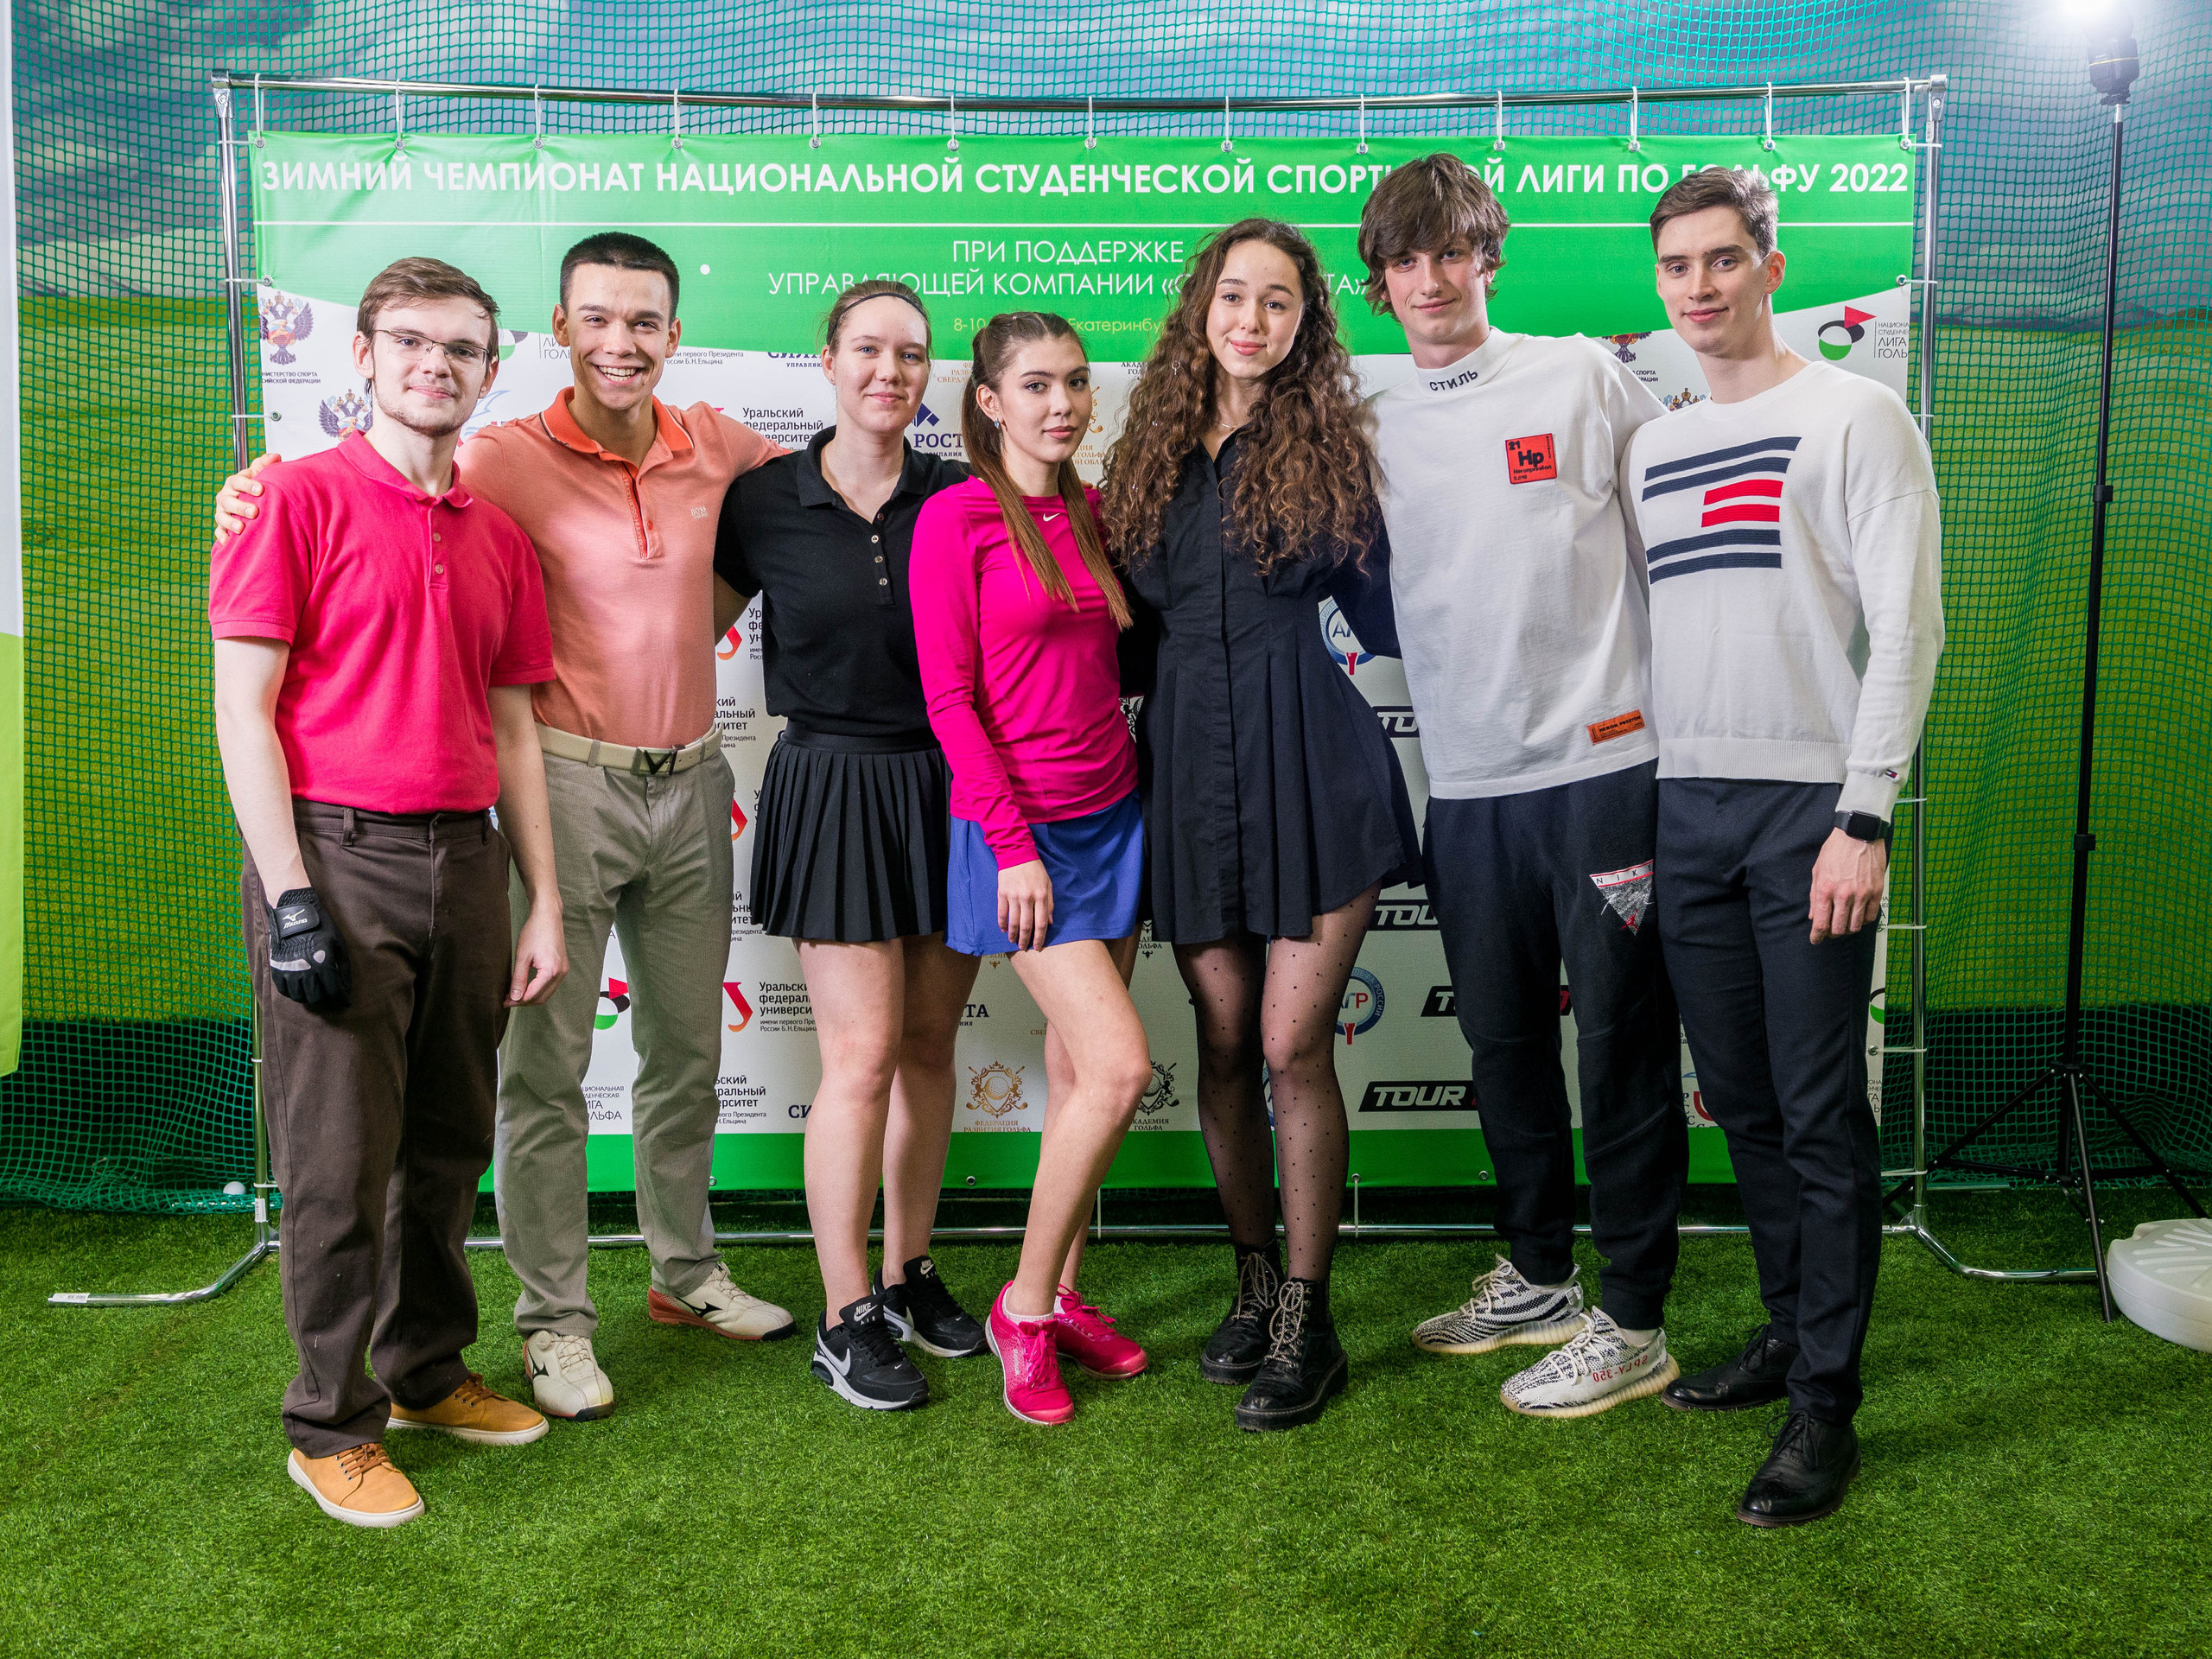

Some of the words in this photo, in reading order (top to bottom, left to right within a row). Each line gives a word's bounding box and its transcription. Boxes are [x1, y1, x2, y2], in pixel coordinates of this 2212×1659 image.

[262, 155, 412, 191] ЗИМНИЙ
[424, 162, 645, 192] ЧЕМПИОНАТ
[656, 156, 963, 195] НАЦИОНАЛЬНОЙ
[975, 157, 1254, 196] СТУДЕНЧЕСКОЙ
[1515, 164, 1604, 193] ЛИГИ
[1618, 163, 1669, 193] ПО
[1828, 162, 1908, 193] 2022
[953, 240, 1005, 263] ПРИ
[1015, 240, 1183, 265] ПОДДЕРЖКЕ
[994, 273, 1154, 296] КОМПАНИИ
[1878, 337, 1907, 346] ЛИГА
[1878, 348, 1908, 359] ГОЛЬ
[1429, 370, 1478, 391] СТИЛЬ
[742, 407, 804, 420] Уральский
[1508, 441, 1521, 451] 21
[1517, 449, 1545, 467] Hp
[1596, 863, 1653, 886] NIKE
[1375, 905, 1439, 925] TOU
[760, 1006, 813, 1017] универси
[1373, 1085, 1467, 1107] TOUR
[855, 1302, 872, 1316] NIKE
